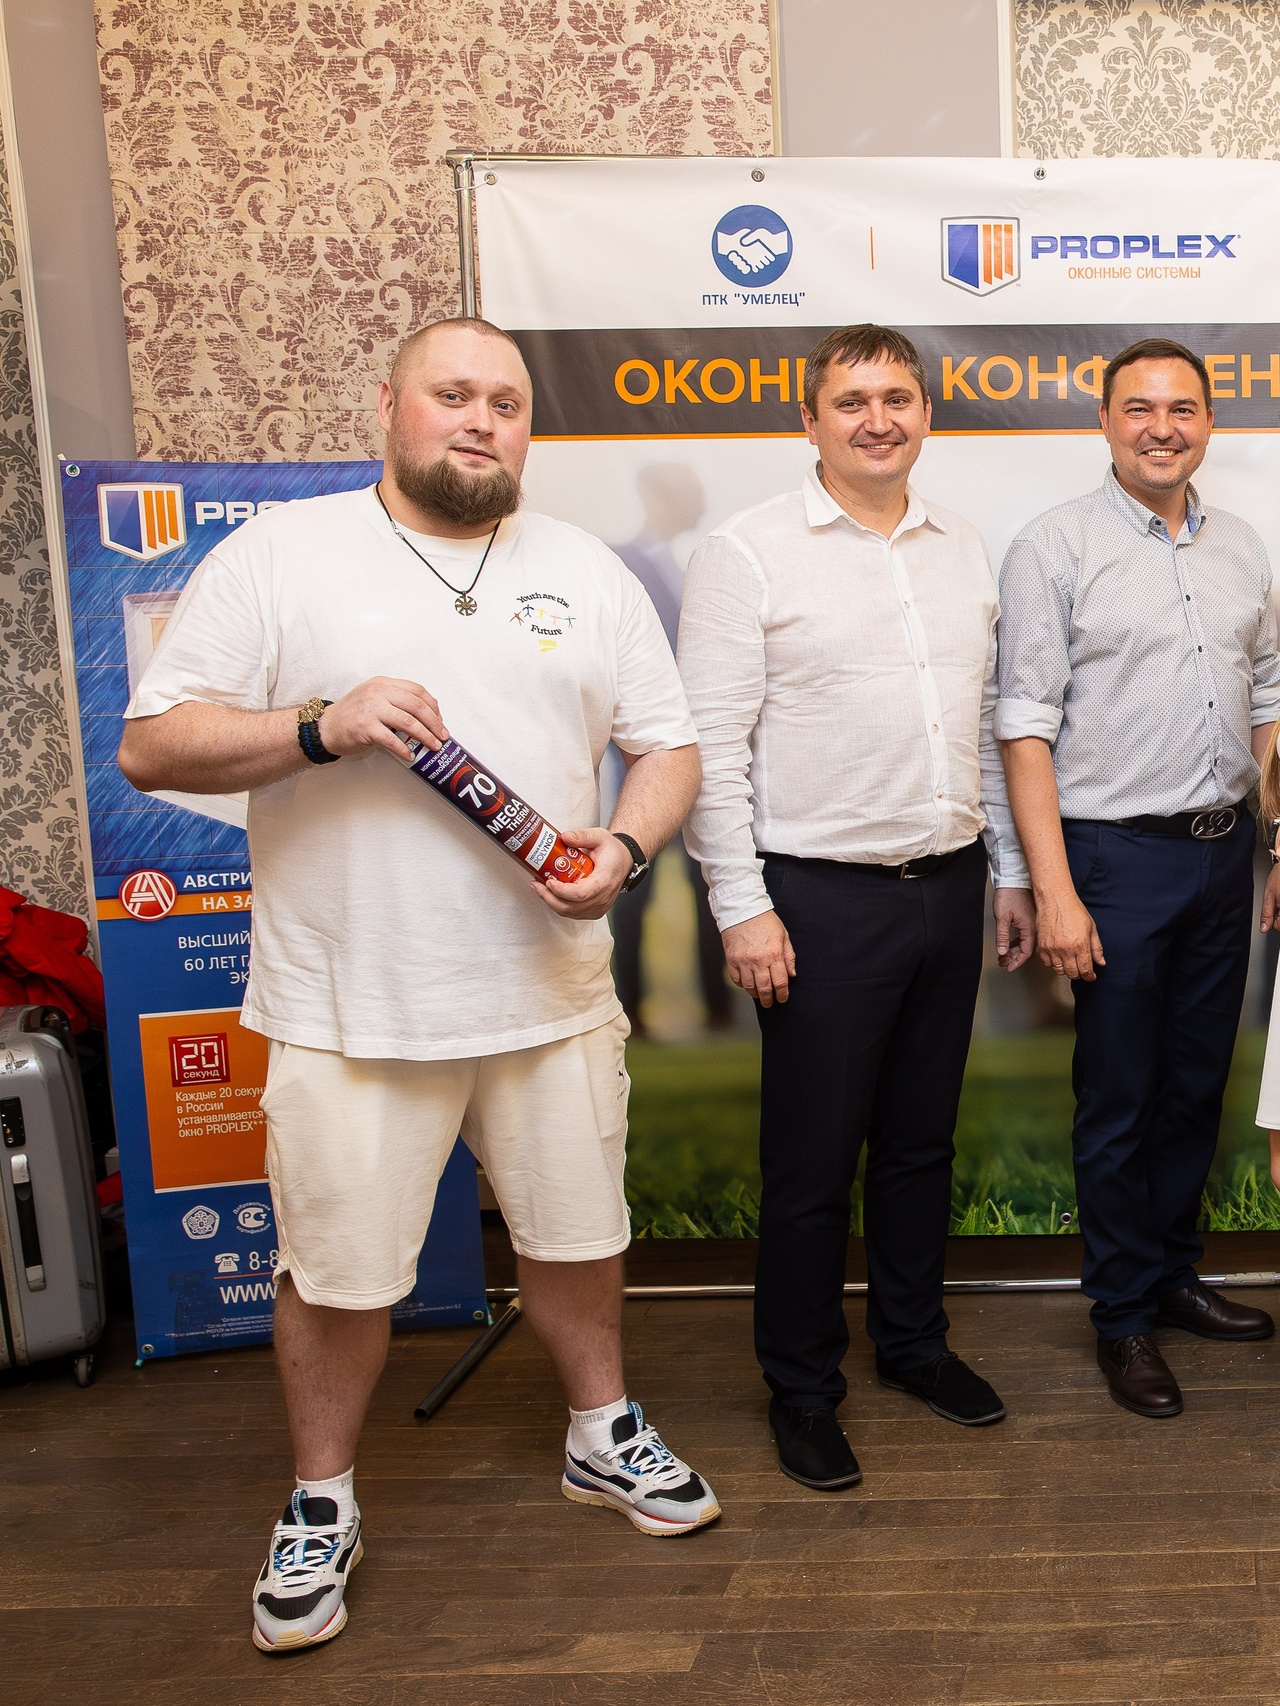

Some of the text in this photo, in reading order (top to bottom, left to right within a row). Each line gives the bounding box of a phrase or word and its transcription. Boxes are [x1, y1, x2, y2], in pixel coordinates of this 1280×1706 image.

[1031, 235, 1237, 259] PROPLEX
[1068, 266, 1201, 279] оконные системы
[702, 292, 806, 307] ПТК "УМЕЛЕЦ"
[614, 357, 805, 405] ОКОН
[516, 592, 570, 608] Youth are the
[531, 624, 562, 635] Future
[458, 773, 497, 809] 70
[486, 798, 524, 835] MEGA
[506, 805, 531, 832] THERM
[533, 833, 556, 865] POLYNOR
[183, 871, 252, 888] АВСТРИ
[202, 895, 252, 910] НА ЗА
[178, 930, 251, 949] ВЫСШИЙ
[184, 958, 205, 971] 60
[208, 955, 237, 970] ЛЕТ
[180, 1041, 220, 1070] 20
[183, 1069, 220, 1079] секунд
[175, 1086, 266, 1102] Каждые 20 секун
[176, 1102, 224, 1114] в России
[177, 1110, 264, 1128] устанавливается
[178, 1127, 204, 1138] окно
[249, 1249, 279, 1271] 8-8
